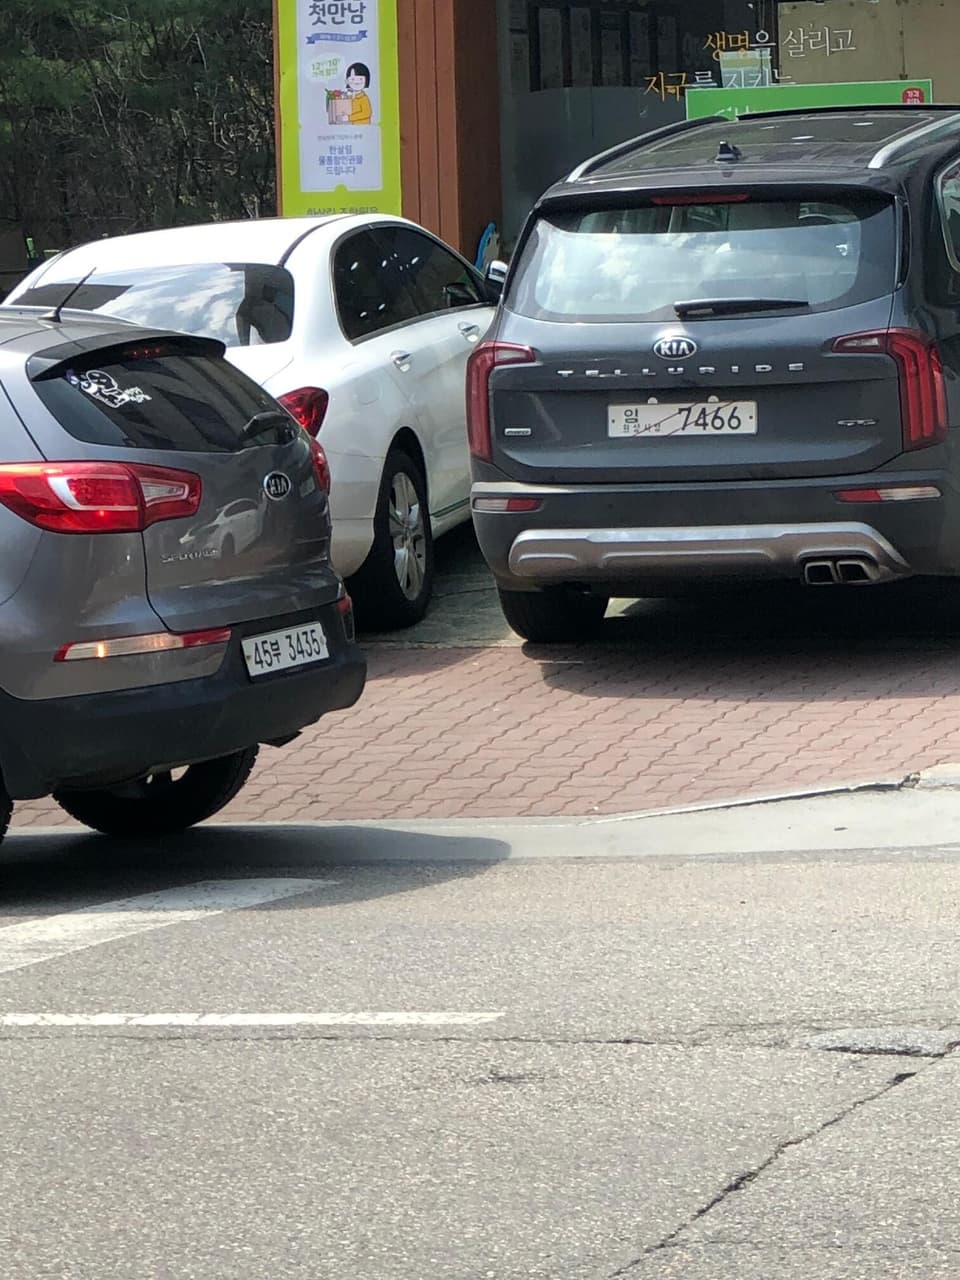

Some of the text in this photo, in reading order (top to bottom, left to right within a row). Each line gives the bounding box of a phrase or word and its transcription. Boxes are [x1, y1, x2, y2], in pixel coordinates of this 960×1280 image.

[308, 2, 367, 26] 첫만남
[702, 26, 857, 62] 생명을 살리고
[657, 339, 692, 357] KIA
[557, 362, 804, 378] TELLURIDE
[623, 406, 743, 432] 임 7466
[267, 475, 289, 497] KIA
[254, 629, 321, 669] 45부 3435
